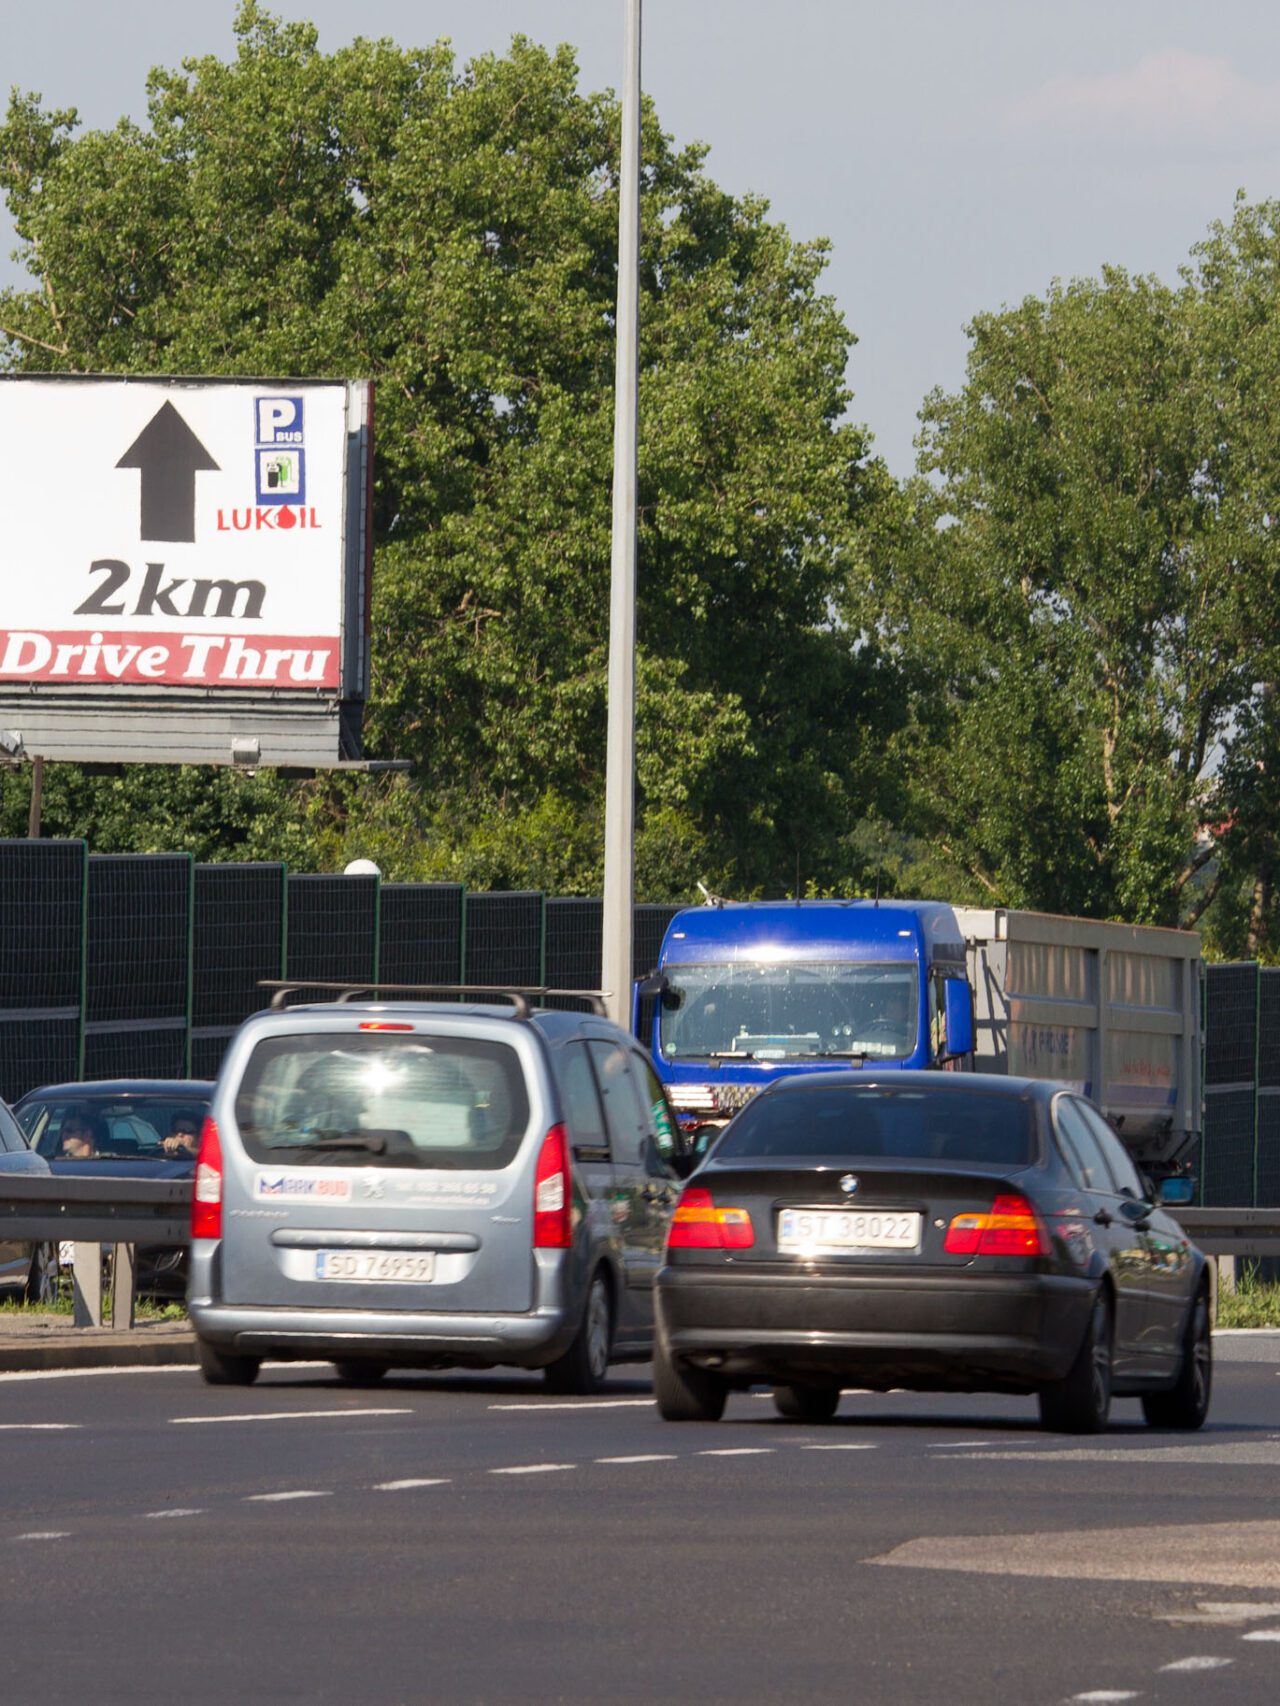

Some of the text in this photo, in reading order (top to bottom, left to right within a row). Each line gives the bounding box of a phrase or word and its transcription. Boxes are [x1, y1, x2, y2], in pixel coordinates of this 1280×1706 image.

[258, 398, 297, 443] P
[276, 431, 303, 442] BUS
[217, 504, 322, 531] LUKOIL
[180, 634, 332, 681] Thru
[798, 1215, 913, 1240] ST 38022
